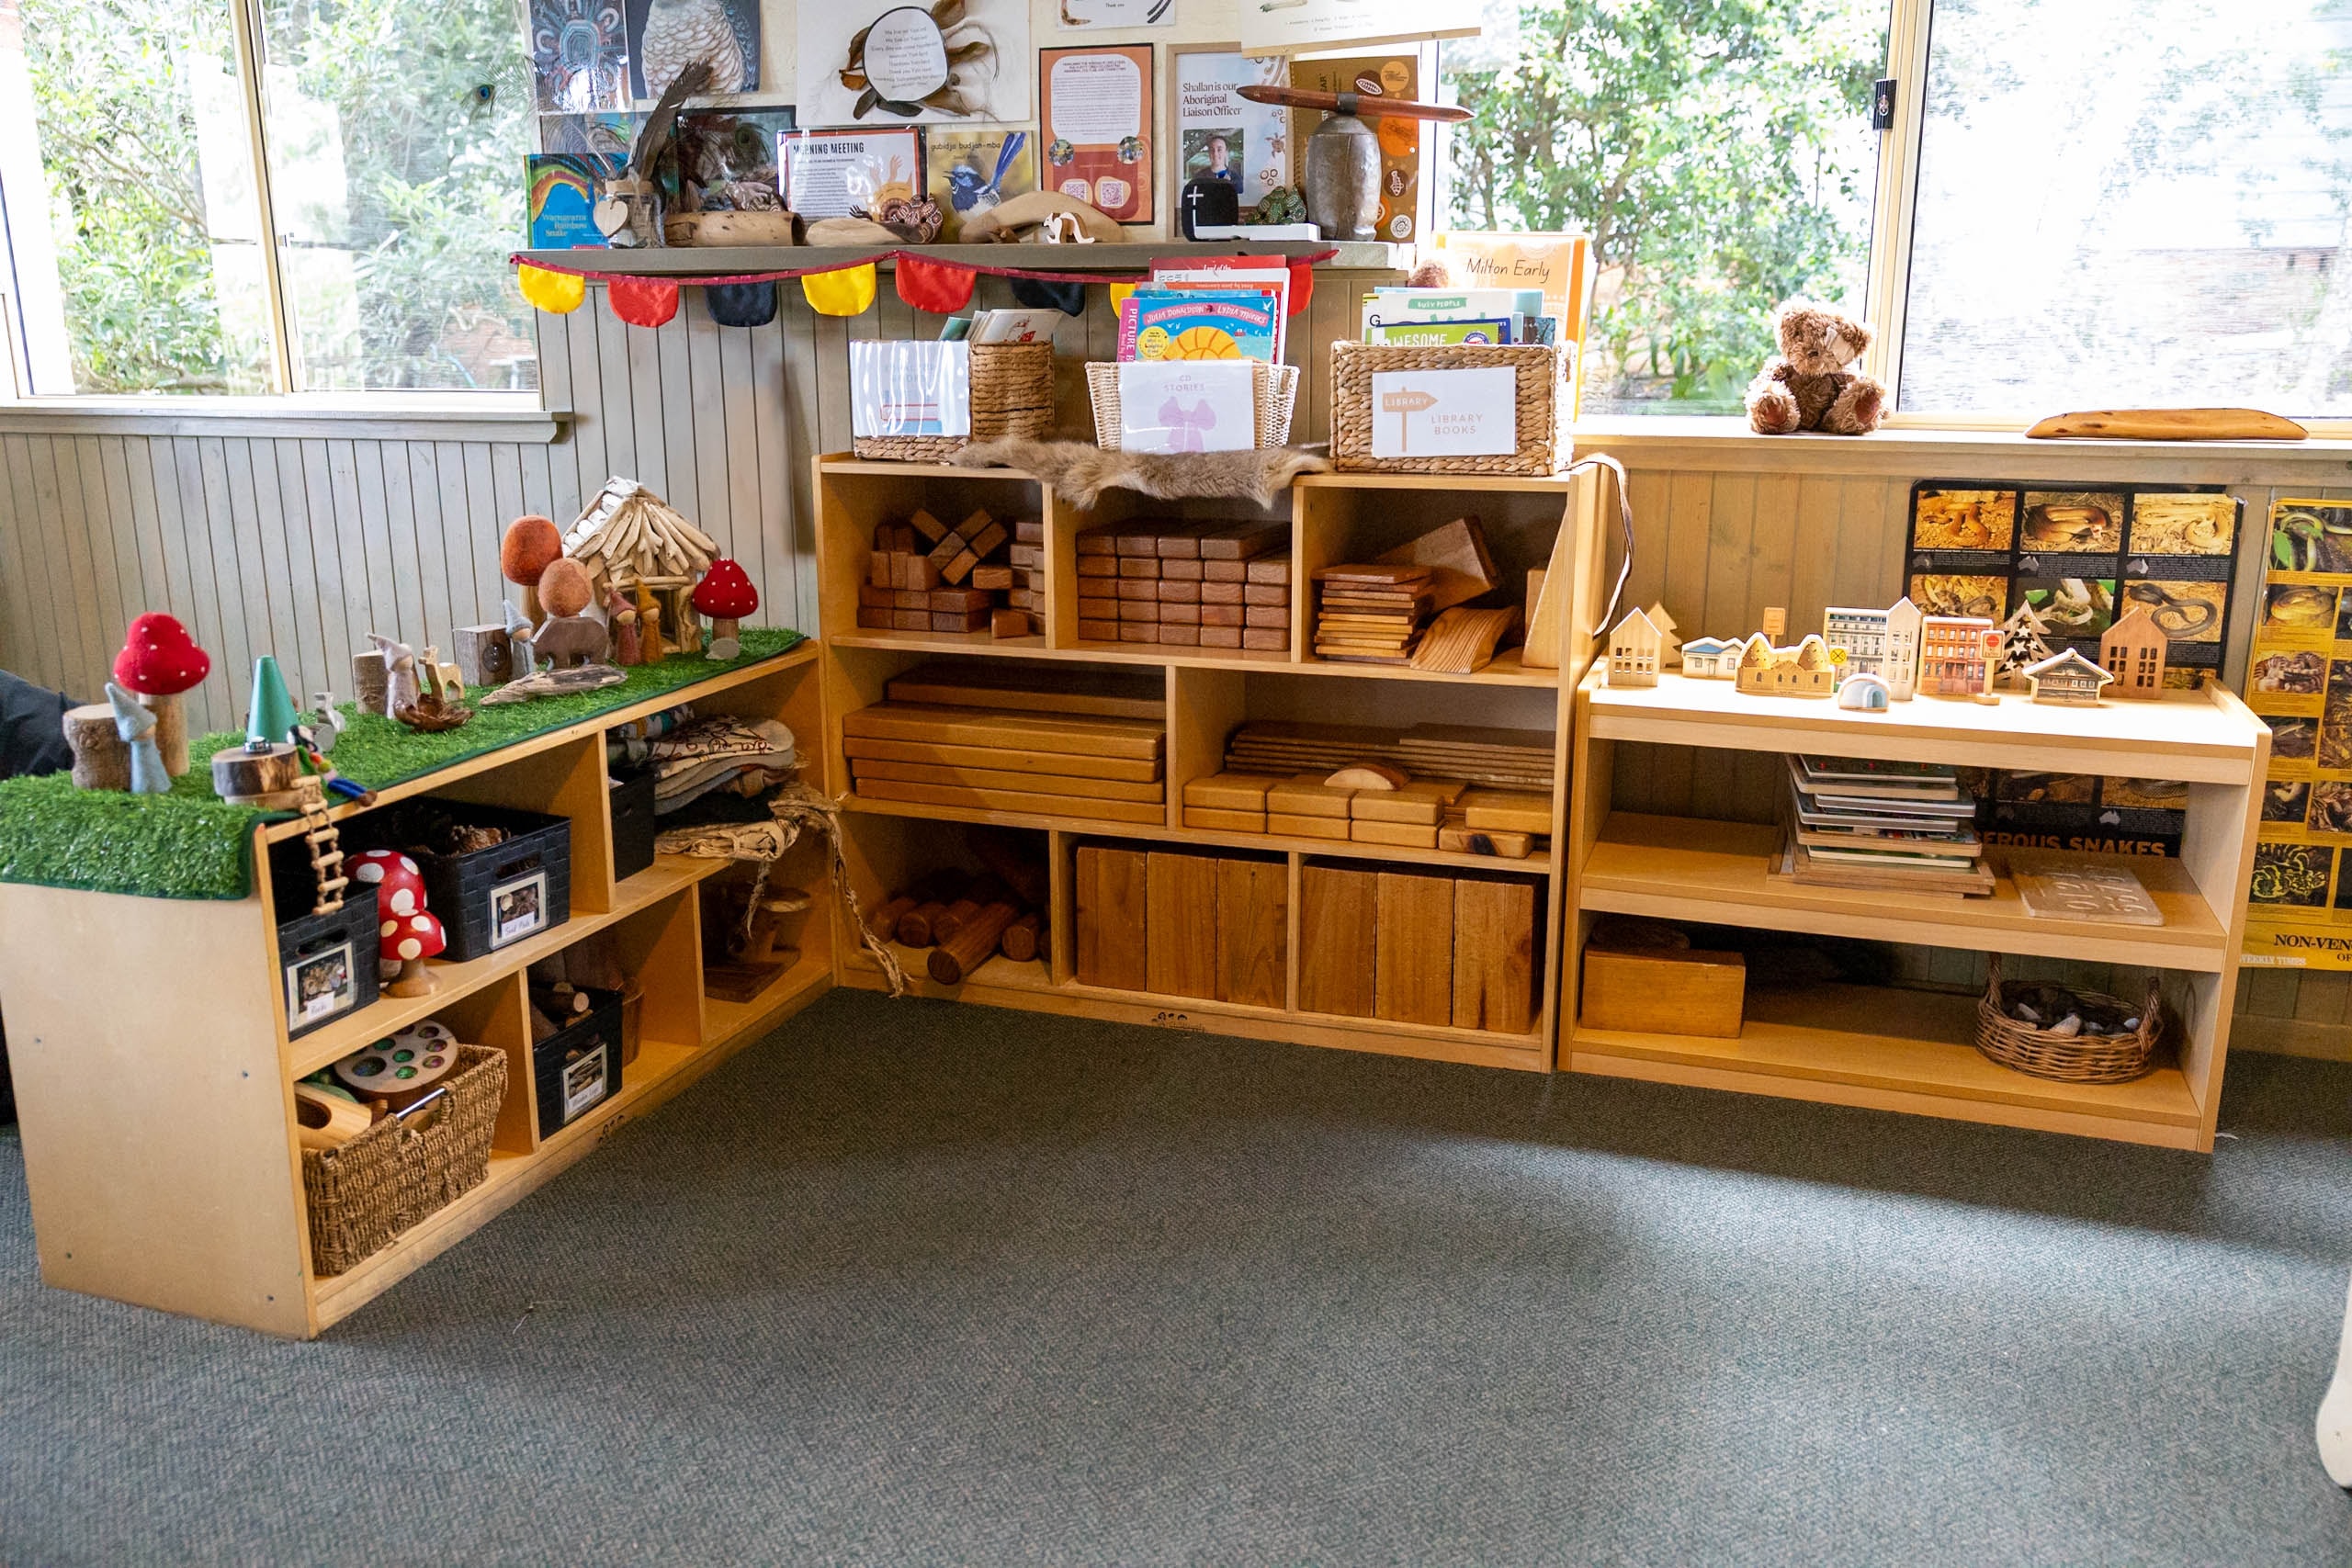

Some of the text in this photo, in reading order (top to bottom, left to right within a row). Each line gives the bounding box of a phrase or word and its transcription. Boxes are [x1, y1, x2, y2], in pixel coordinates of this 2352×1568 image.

[1182, 81, 1238, 93] Shallan is our
[1182, 93, 1227, 106] Aboriginal
[1182, 105, 1243, 117] Liaison Officer
[831, 141, 865, 153] MEETING
[1465, 257, 1550, 284] Milton Early
[1436, 299, 1461, 308] PEOPLE
[1147, 310, 1166, 323] JULIA
[1217, 305, 1239, 316] LYDIA
[1125, 308, 1138, 351] PICTURE
[1393, 333, 1448, 346] WESOME
[1179, 374, 1193, 382] CD
[1163, 383, 1205, 391] STORIES
[1385, 396, 1428, 407] LIBRARY
[1430, 413, 1484, 424] LIBRARY
[1434, 425, 1476, 434] BOOKS
[2069, 836, 2166, 858] SNAKES
